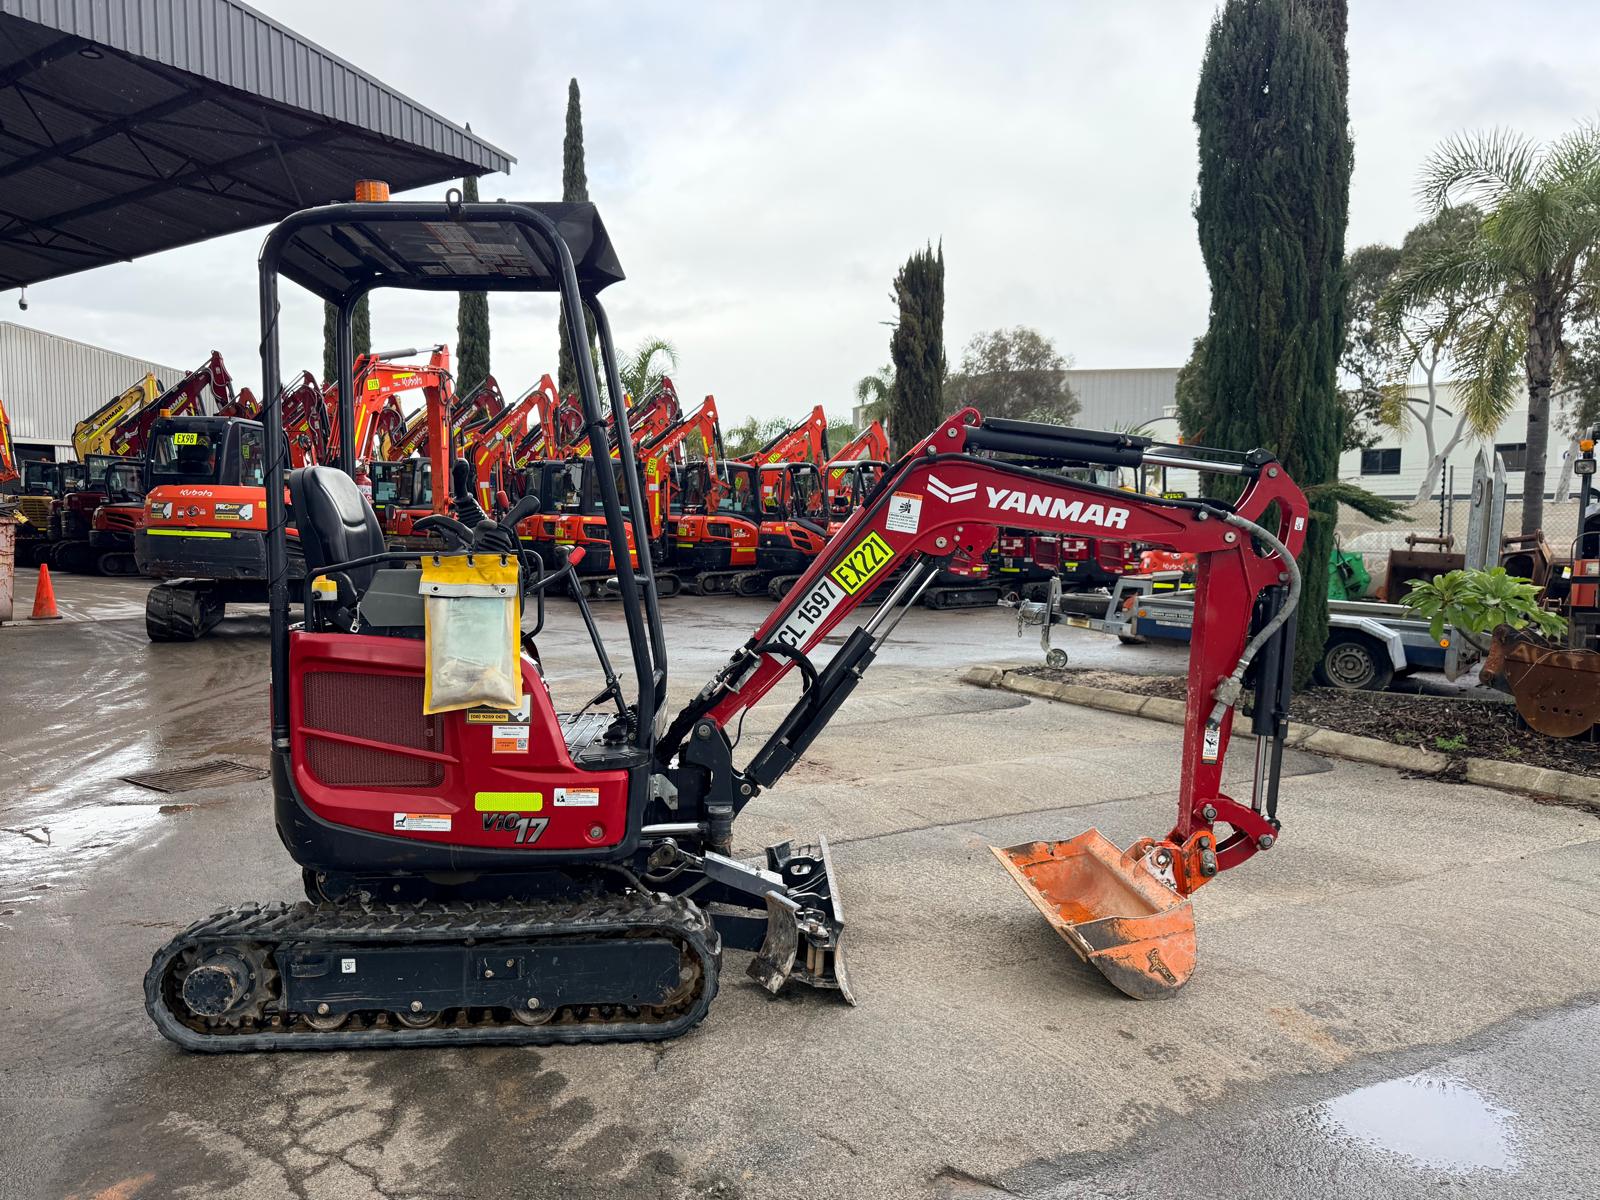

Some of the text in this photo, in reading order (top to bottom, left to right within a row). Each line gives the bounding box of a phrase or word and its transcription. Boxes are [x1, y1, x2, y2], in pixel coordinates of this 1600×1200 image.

[98, 405, 124, 427] YANMAR
[452, 414, 468, 429] MAR
[176, 433, 196, 444] EX98
[179, 488, 213, 497] Kubota
[986, 486, 1130, 530] YANMAR
[835, 536, 889, 590] EX221
[797, 580, 837, 625] 1597
